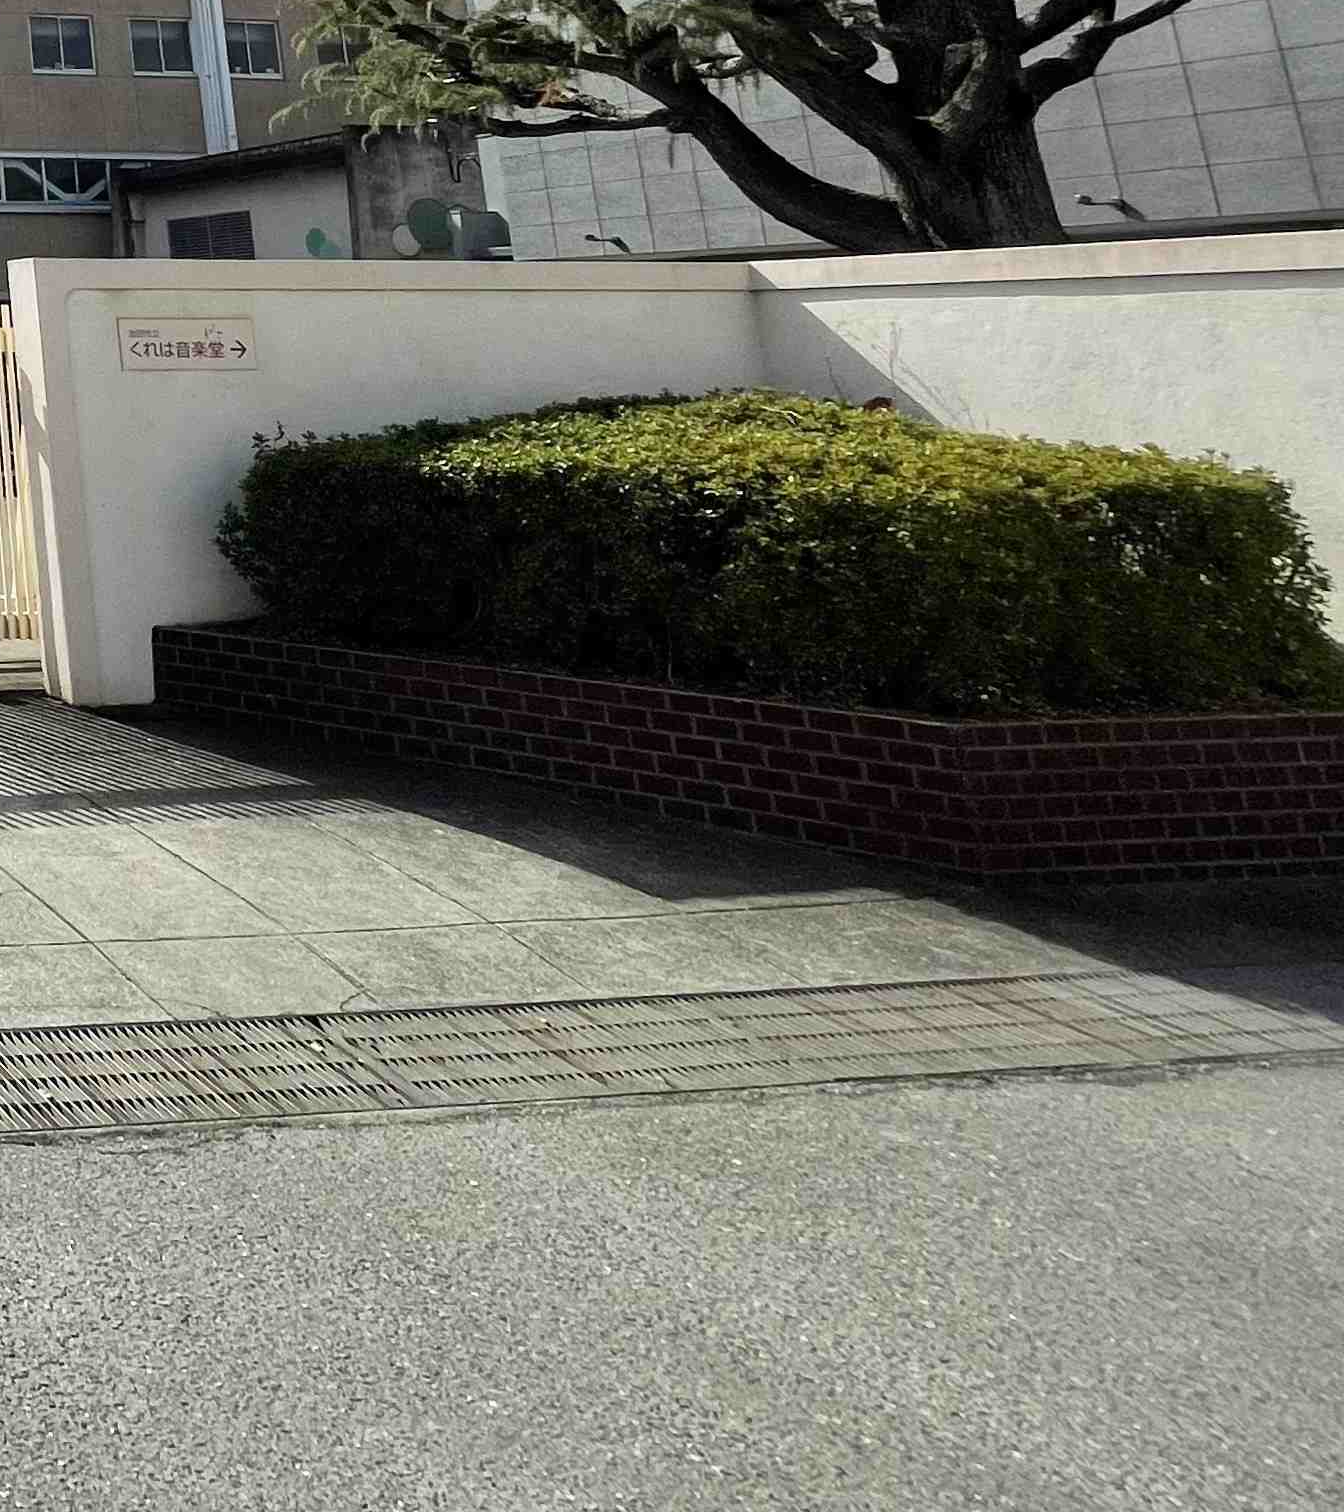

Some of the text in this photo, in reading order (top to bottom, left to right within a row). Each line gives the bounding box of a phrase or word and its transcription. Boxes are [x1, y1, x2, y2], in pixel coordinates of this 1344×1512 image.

[129, 341, 225, 359] くれは音楽堂
